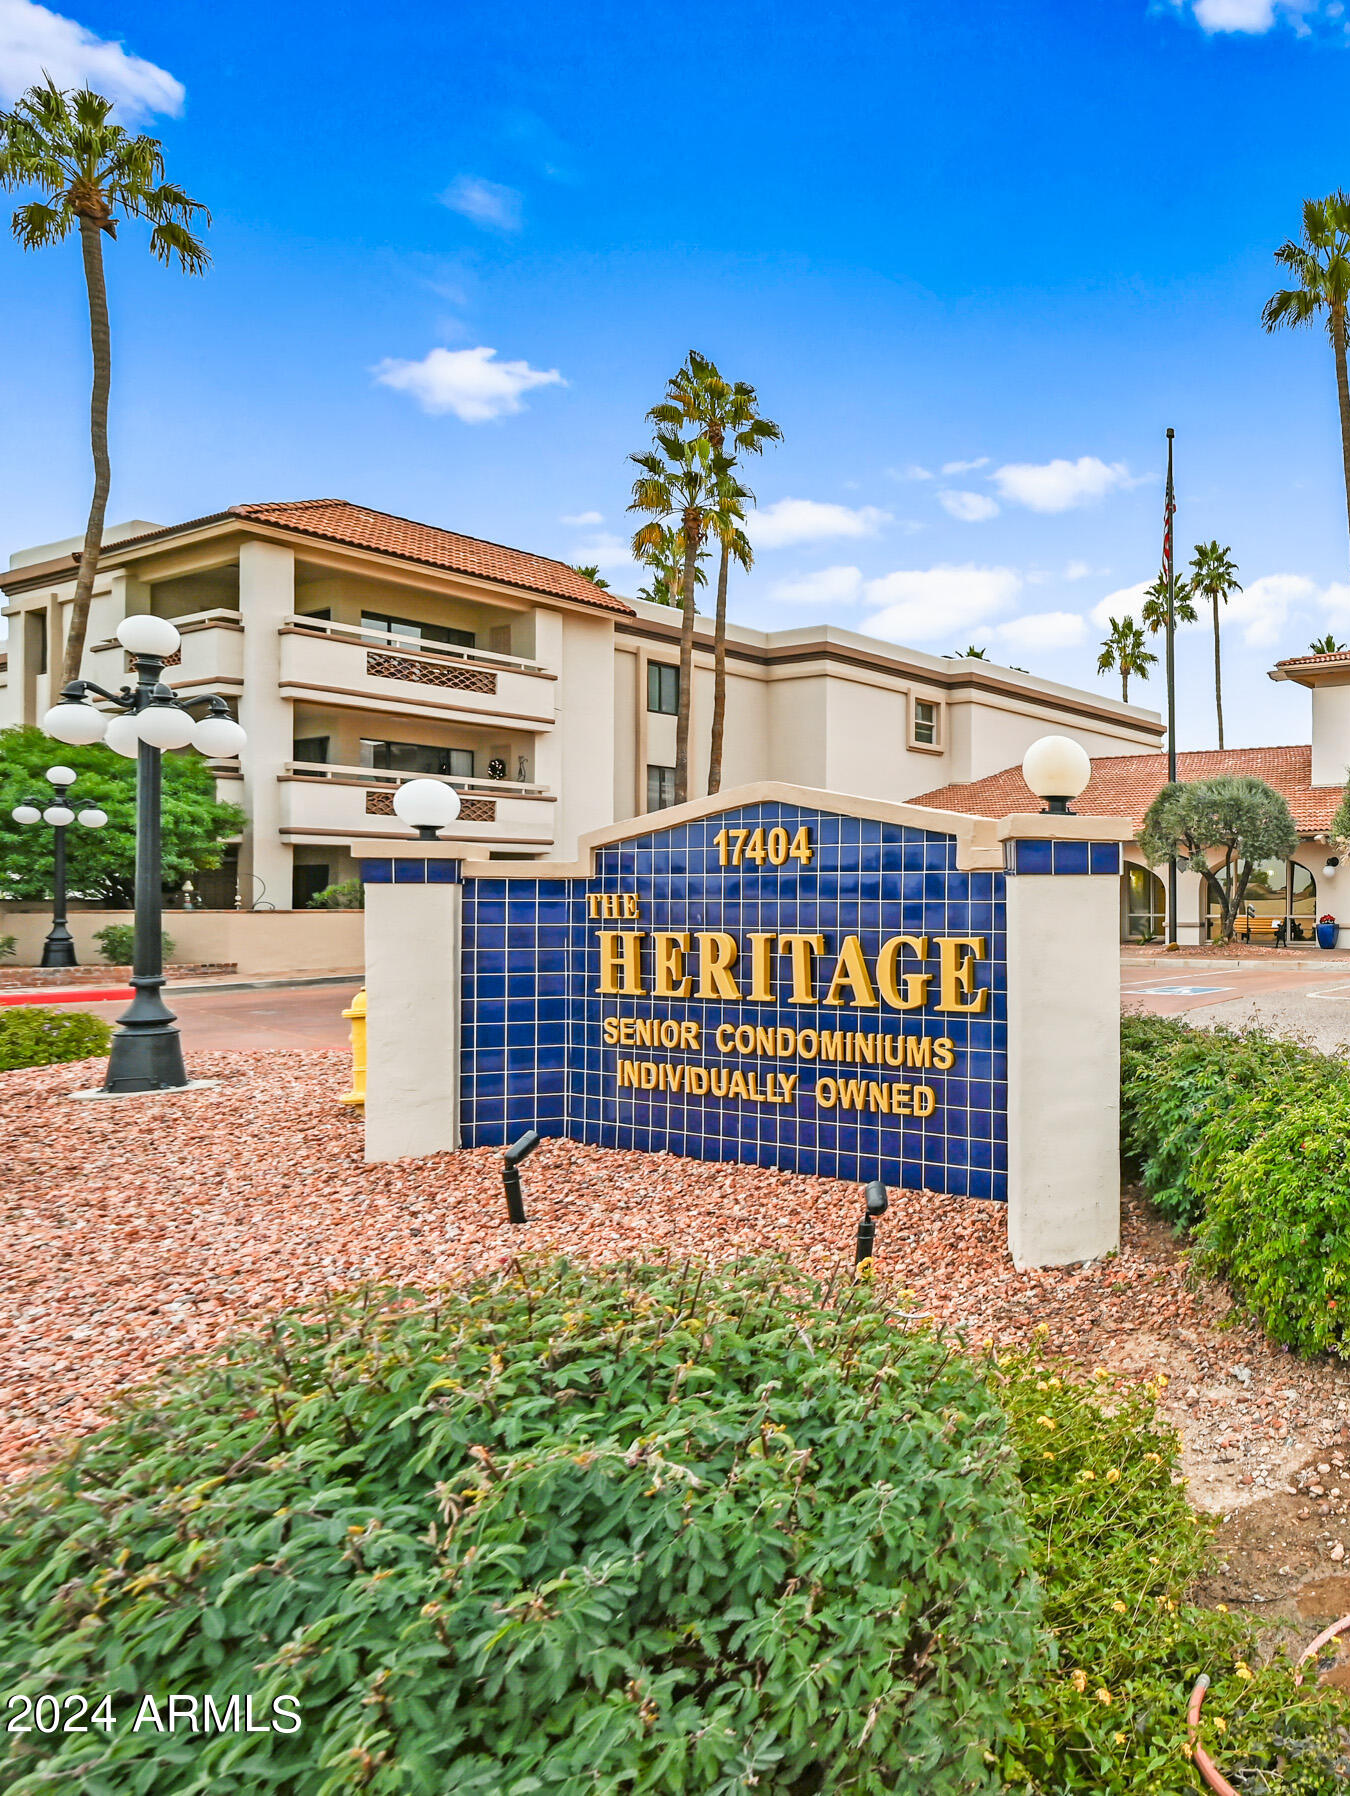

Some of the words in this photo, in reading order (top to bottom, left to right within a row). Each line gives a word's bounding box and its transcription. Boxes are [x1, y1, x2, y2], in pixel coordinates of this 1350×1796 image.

[713, 826, 813, 866] 17404
[585, 893, 640, 920] THE
[594, 930, 989, 1014] HERITAGE
[603, 1016, 701, 1051] SENIOR
[715, 1023, 956, 1070] CONDOMINIUMS
[616, 1059, 799, 1104] INDIVIDUALLY
[815, 1077, 937, 1118] OWNED
